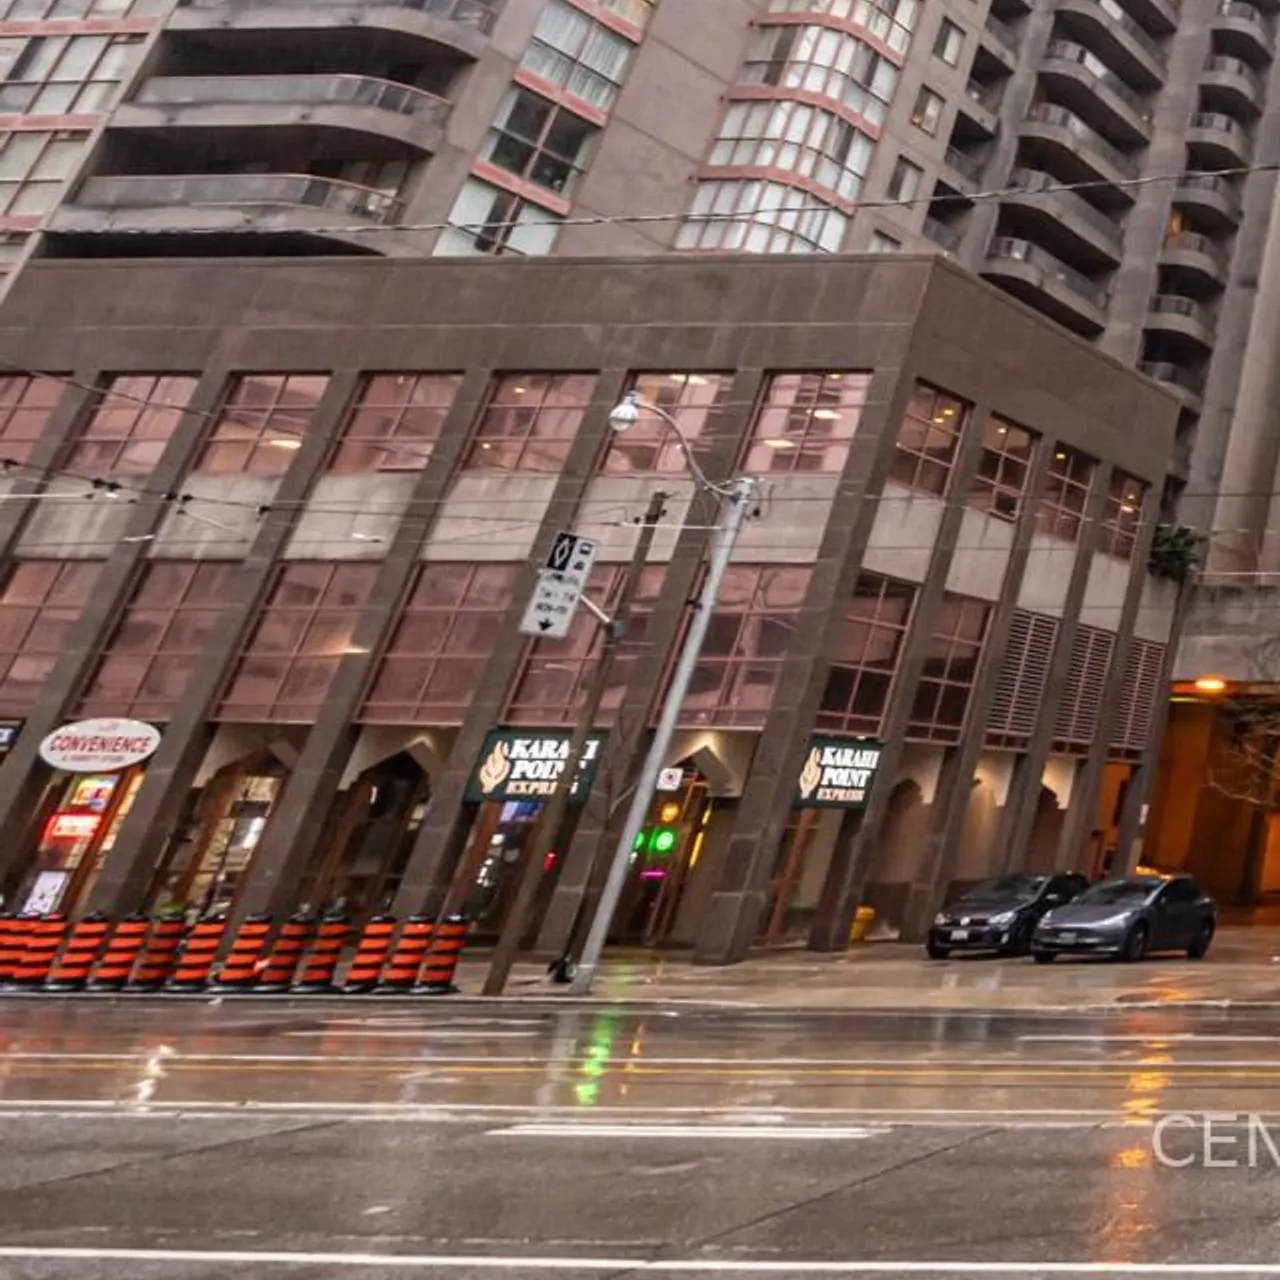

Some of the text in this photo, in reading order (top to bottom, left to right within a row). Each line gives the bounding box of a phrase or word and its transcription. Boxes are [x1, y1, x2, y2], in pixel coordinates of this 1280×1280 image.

[50, 735, 152, 754] CONVENIENCE
[508, 739, 600, 759] KARAI
[820, 746, 880, 770] KARAHI
[820, 766, 872, 788] POINT
